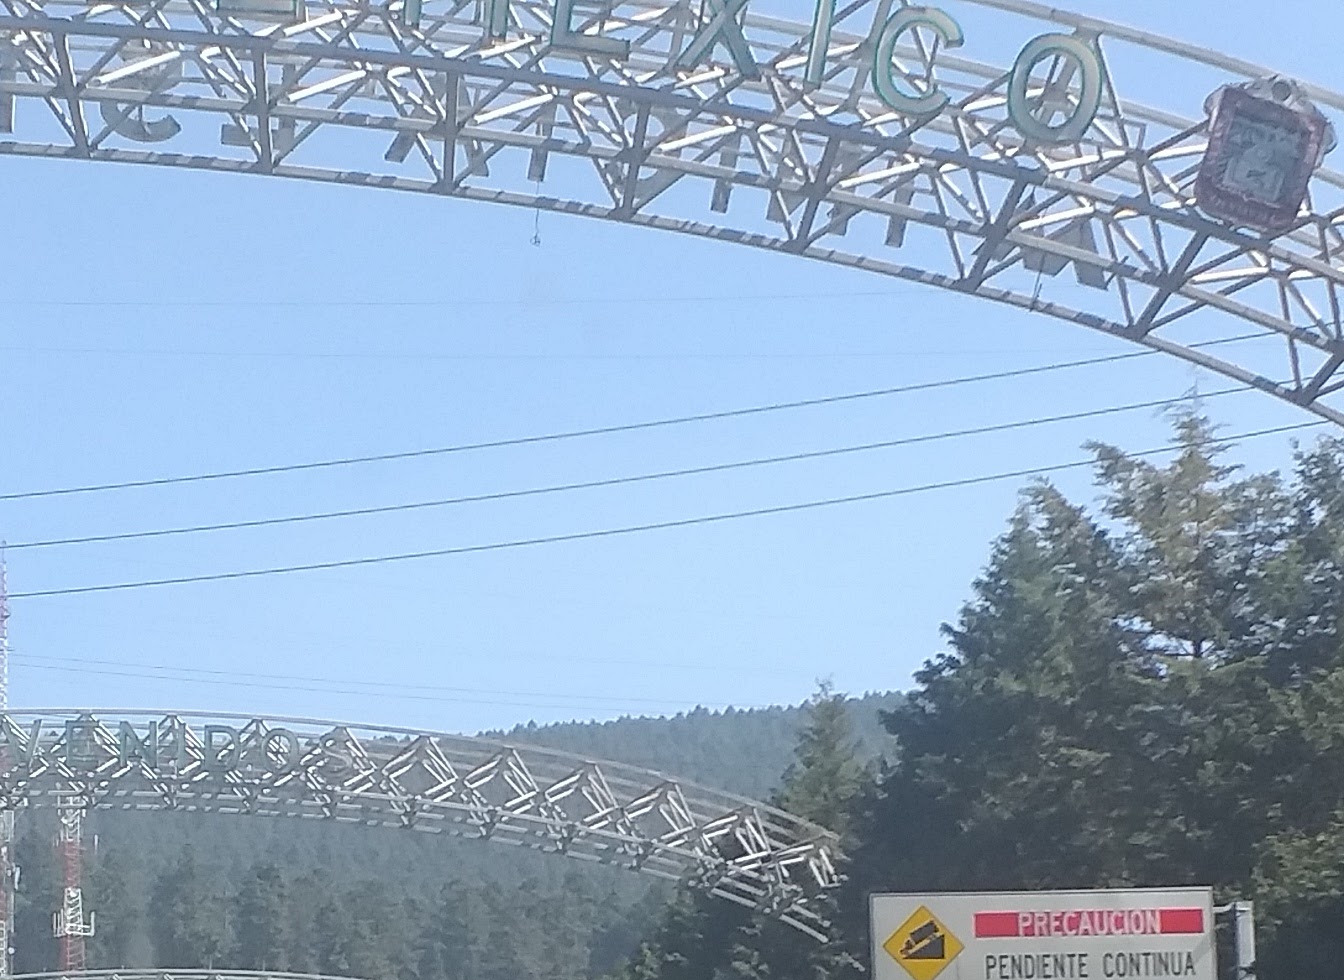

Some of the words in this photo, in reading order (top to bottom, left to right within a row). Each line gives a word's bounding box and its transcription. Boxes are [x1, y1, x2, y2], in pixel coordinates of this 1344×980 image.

[1018, 910, 1160, 936] PRECAUCION
[985, 953, 1089, 979] PENDIENTE
[1102, 952, 1196, 978] CONTINUA
